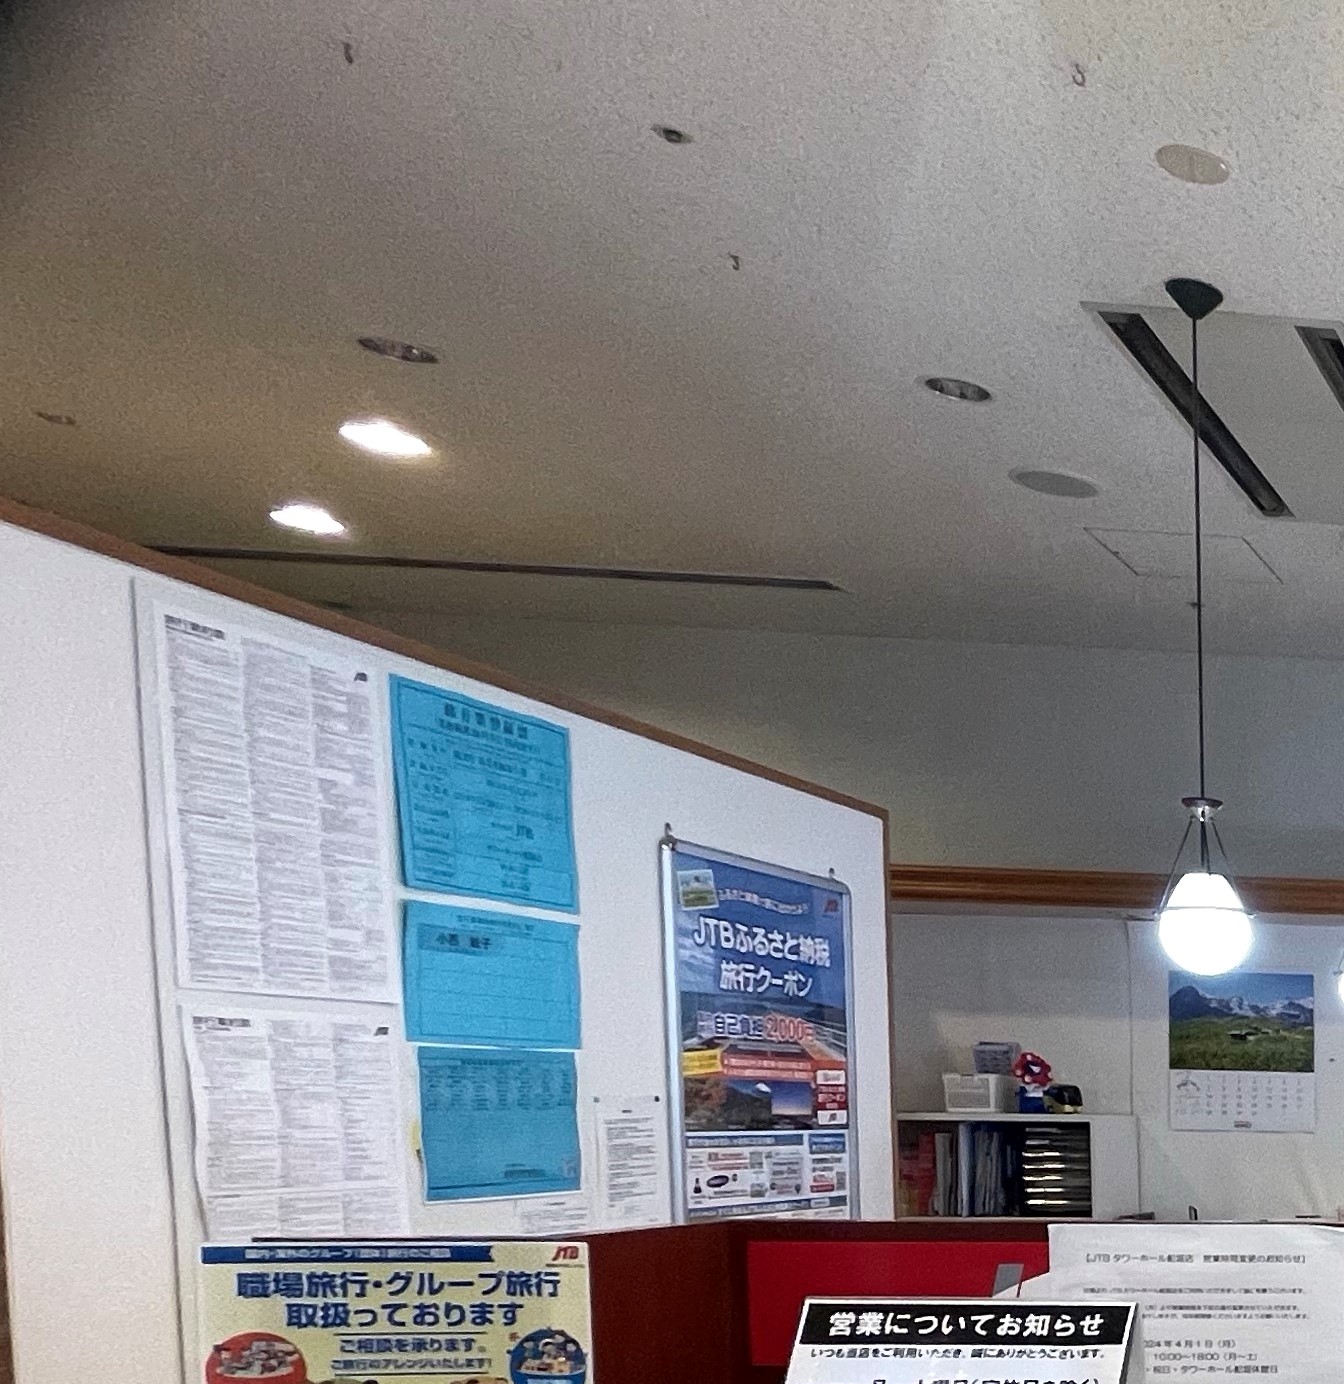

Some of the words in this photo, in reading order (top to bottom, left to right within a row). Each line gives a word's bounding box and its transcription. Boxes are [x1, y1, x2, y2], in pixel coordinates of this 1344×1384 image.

[693, 916, 831, 967] JTBふるさと納税
[719, 959, 813, 997] 旅行クーポン
[236, 1271, 562, 1298] 職場旅行・グループ旅行
[286, 1302, 525, 1329] 取扱っております
[828, 1312, 1105, 1337] 営業についてお知らせ
